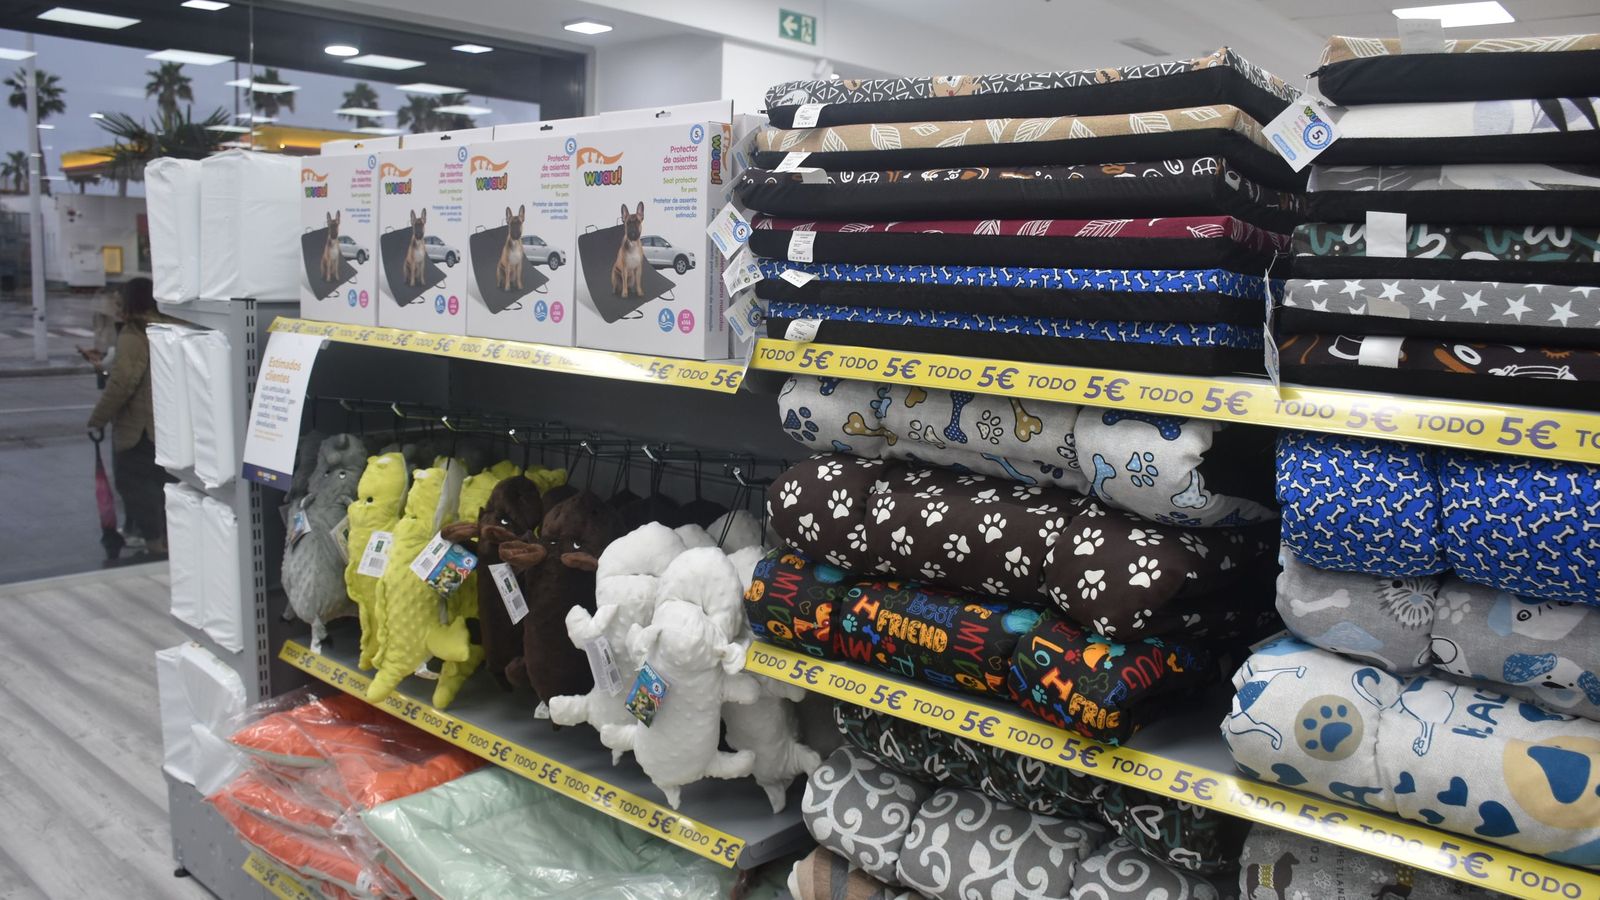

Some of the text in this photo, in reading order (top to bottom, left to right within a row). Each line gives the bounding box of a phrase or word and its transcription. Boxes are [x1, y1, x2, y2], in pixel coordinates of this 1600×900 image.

[664, 154, 697, 164] de asientos
[670, 145, 698, 153] Protector
[584, 166, 623, 186] wuau!
[662, 162, 698, 172] para mascotas
[674, 177, 697, 186] protector
[355, 329, 374, 340] 5€
[374, 332, 392, 342] TODO
[392, 334, 412, 346] 5€
[413, 338, 434, 347] TODO
[433, 337, 456, 352] 5€
[460, 342, 482, 352] TODO
[482, 342, 506, 359] 5€
[506, 348, 531, 360] TODO
[532, 348, 552, 366] 5€
[269, 357, 302, 371] Estimados
[645, 362, 674, 380] 5€
[676, 367, 708, 380] TODO
[710, 368, 743, 388] 5€
[265, 370, 290, 384] clientes
[760, 346, 795, 362] TODO
[798, 348, 834, 370] 5€
[838, 355, 879, 372] TODO
[882, 357, 922, 380] 5€
[927, 364, 972, 380] TODO
[977, 366, 1020, 390] 5€
[1027, 374, 1078, 392] TODO
[1083, 375, 1130, 402] 5€
[1139, 384, 1194, 404] TODO
[1201, 387, 1254, 416] 5€
[1273, 398, 1336, 420] TODO
[1345, 402, 1402, 432] 5€
[1415, 414, 1484, 436] TODO
[1496, 416, 1561, 450] 5€
[876, 608, 948, 653] FRIEND
[299, 652, 316, 668] 5€
[330, 668, 348, 685] 5€
[348, 677, 365, 692] TODO
[384, 694, 740, 862] ODO 5€ TODO 5€ TODO 5€ TODO 5€ TODO 5€ TODO 5€ TODO 5€
[752, 650, 787, 670] TODO
[789, 659, 825, 684] 5€
[828, 673, 867, 695] TODO
[870, 684, 908, 711] 5€
[912, 698, 956, 721] TODO
[959, 710, 1001, 738] 5€
[1007, 726, 1054, 750] TODO
[1058, 738, 1105, 768] 5€
[1112, 756, 1163, 781] TODO
[1169, 770, 1219, 801] 5€
[1230, 788, 1286, 814] TODO
[1296, 803, 1348, 834] 5€
[1360, 824, 1424, 852] TODO
[1435, 841, 1494, 879] 5€
[1507, 865, 1582, 899] TODO
